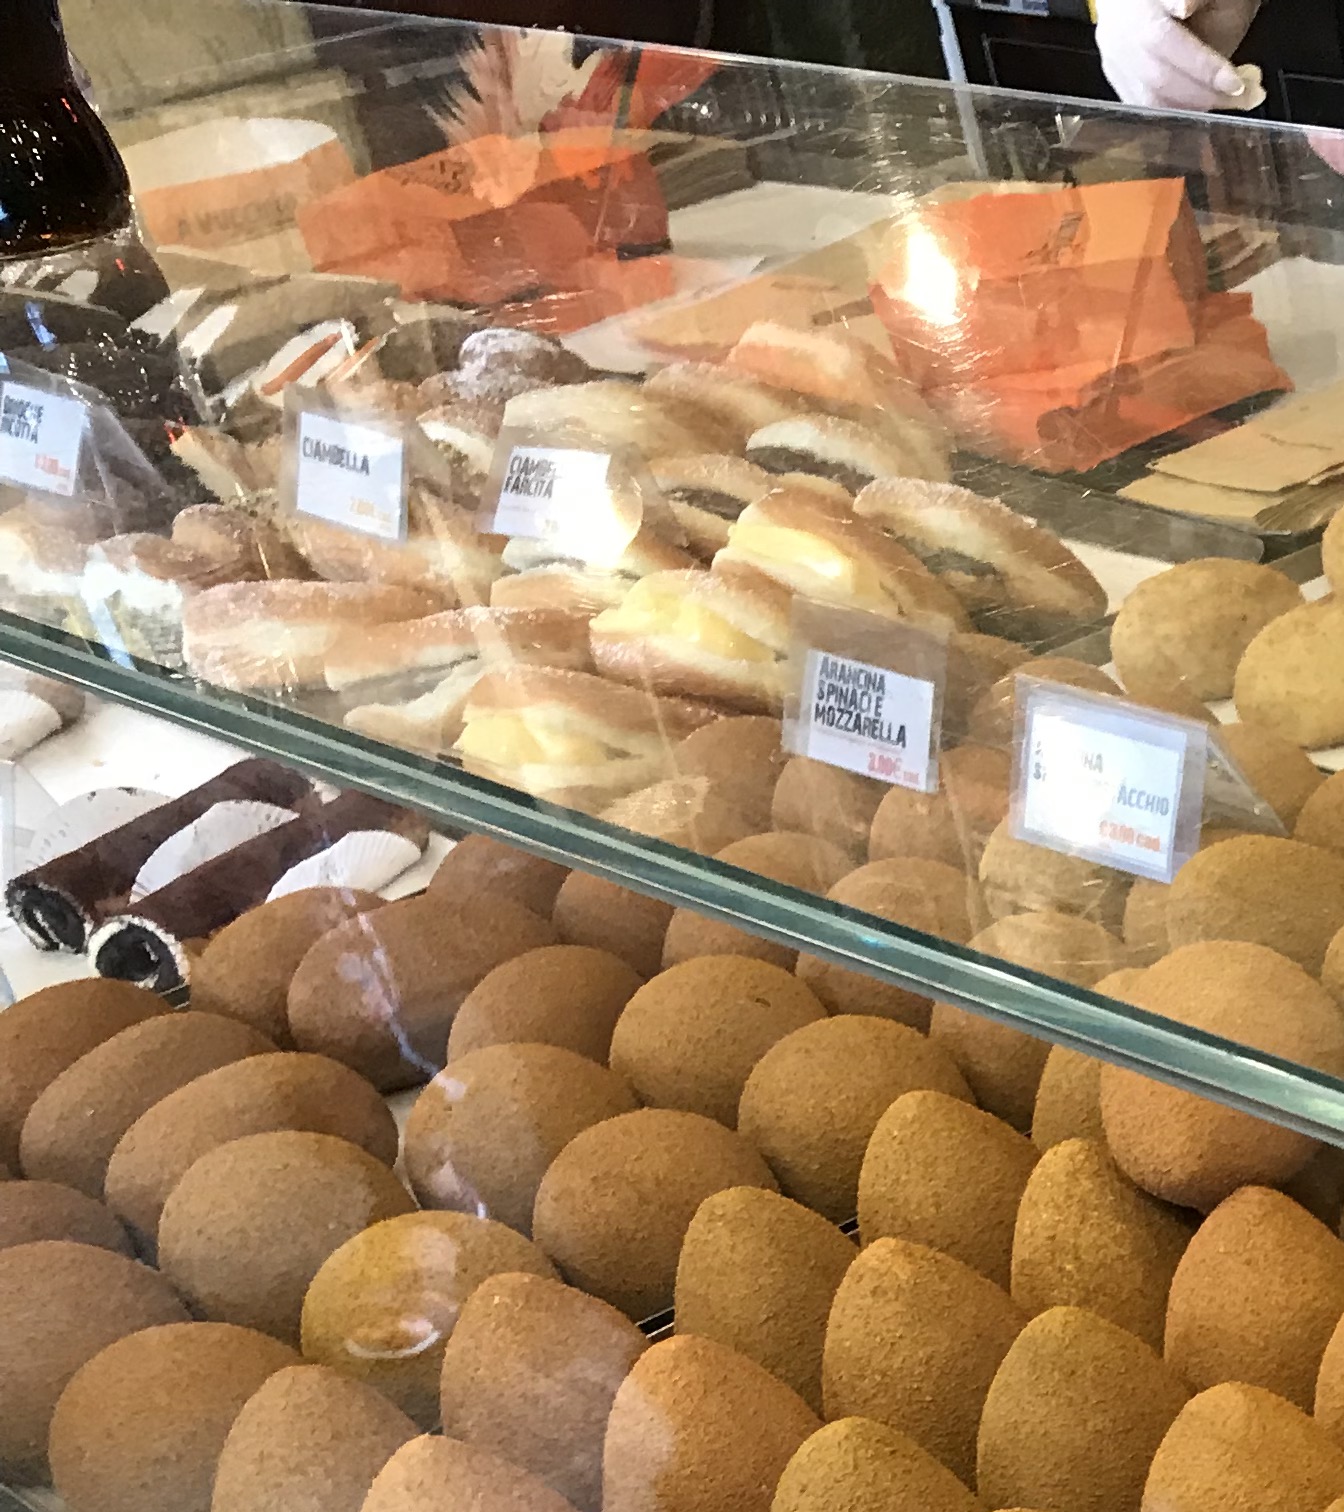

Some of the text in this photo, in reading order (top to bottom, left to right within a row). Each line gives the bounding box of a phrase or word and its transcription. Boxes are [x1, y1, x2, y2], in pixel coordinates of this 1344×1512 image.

[819, 656, 886, 696] ARANCINA
[814, 703, 907, 749] MOZZARELLA
[1117, 784, 1170, 816] ACCHIO
